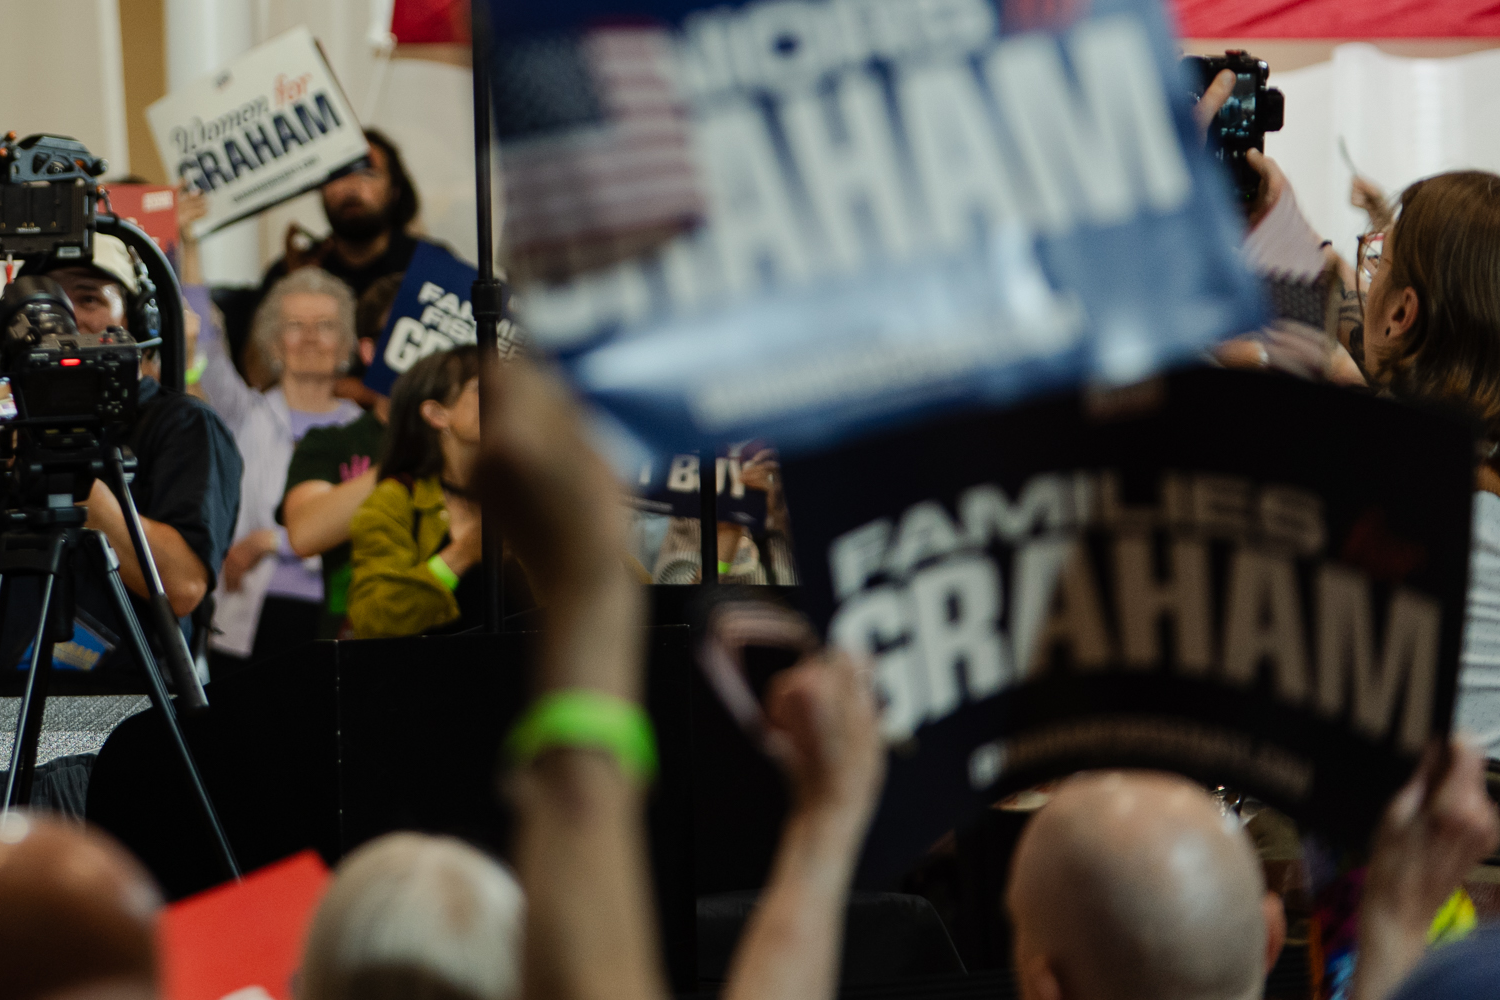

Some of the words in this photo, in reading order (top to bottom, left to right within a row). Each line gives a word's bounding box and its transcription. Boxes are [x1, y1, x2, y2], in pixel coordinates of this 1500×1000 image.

[171, 96, 269, 153] Women
[274, 73, 312, 110] for
[178, 93, 341, 192] GRAHAM
[829, 472, 1326, 600] FAMILIES
[828, 535, 1440, 756] GRAHAM
